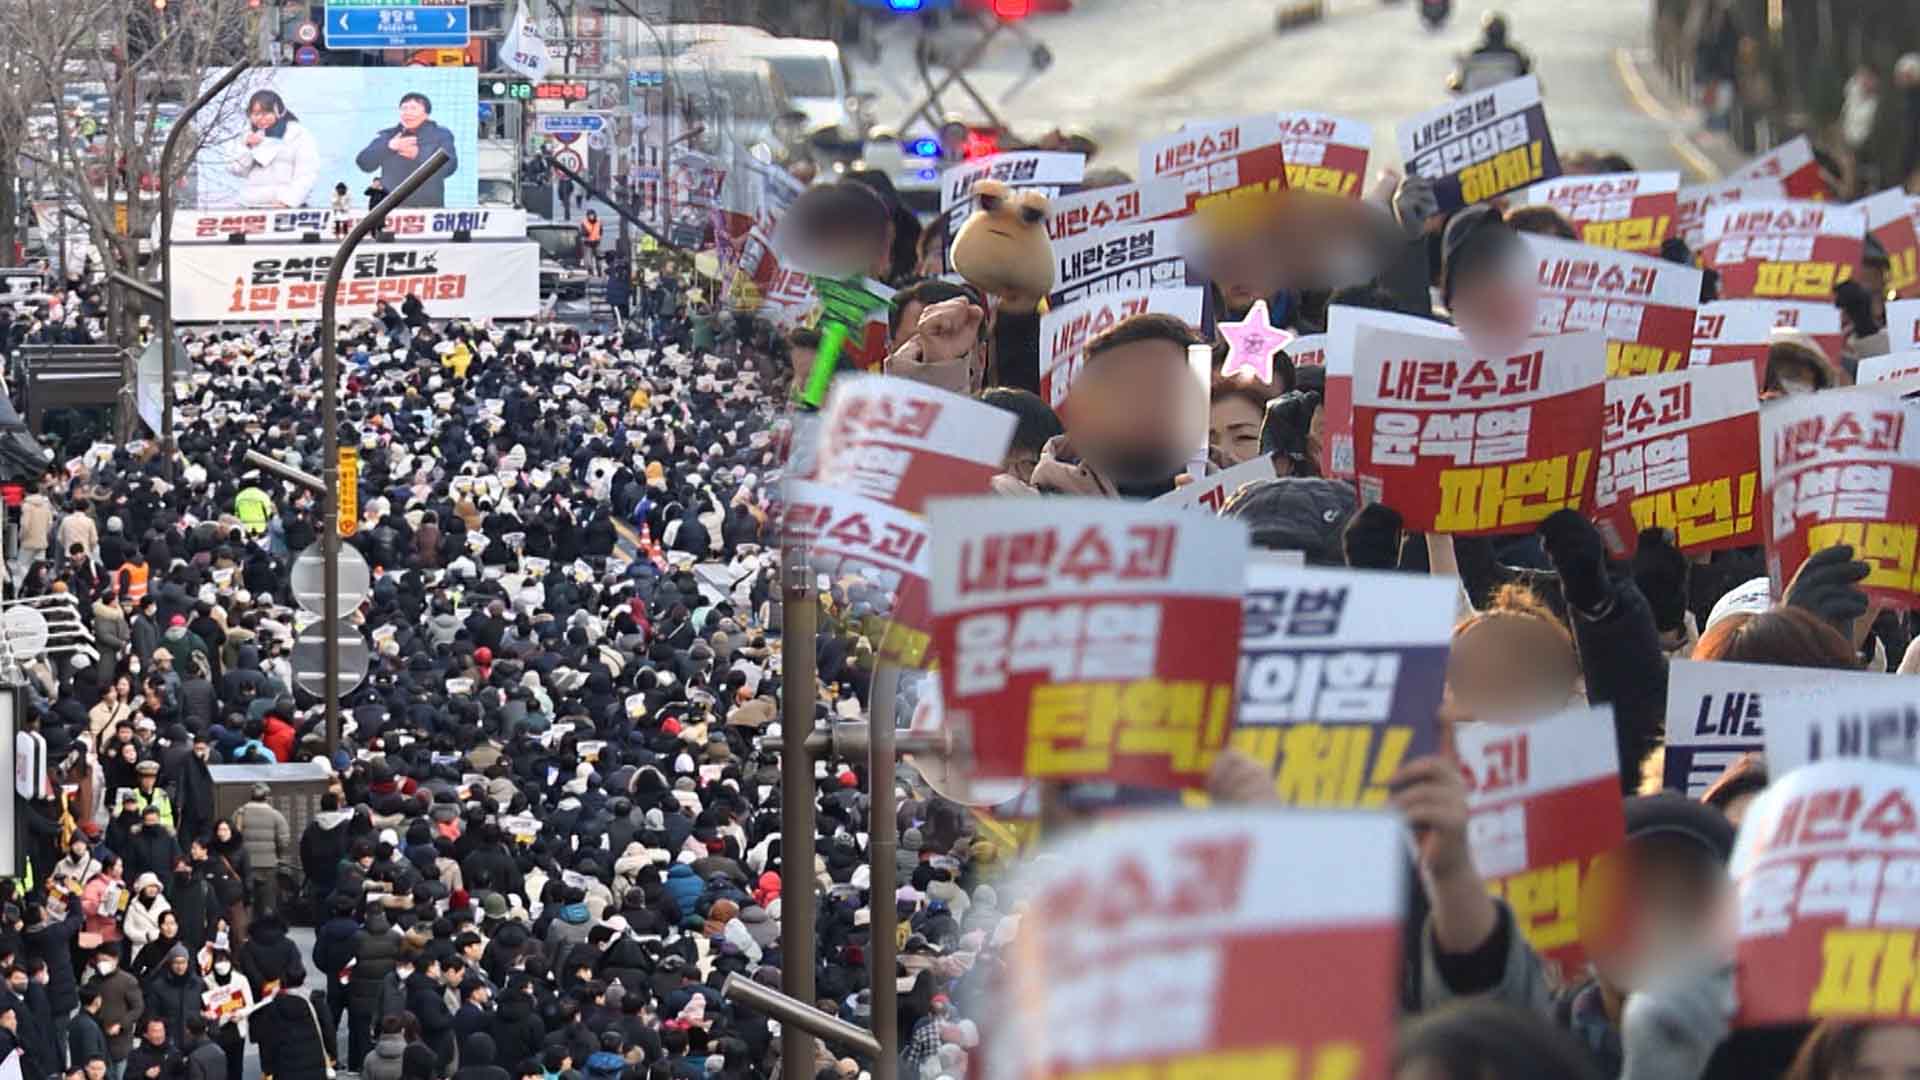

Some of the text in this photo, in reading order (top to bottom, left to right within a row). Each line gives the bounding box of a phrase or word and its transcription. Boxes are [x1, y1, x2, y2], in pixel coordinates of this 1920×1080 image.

[1155, 125, 1239, 176] 내란수괴
[1459, 139, 1544, 205] 해체!
[196, 215, 267, 236] 윤석열
[273, 211, 330, 232] 탄핵!
[432, 211, 488, 231] 해체!
[1046, 190, 1140, 241] 내란수괴
[354, 250, 438, 279] 퇴진
[1060, 230, 1155, 285] 내란공범
[1537, 258, 1658, 296] 내란수괴
[1378, 351, 1544, 402] 내란수괴
[1370, 405, 1534, 467] 윤석열
[1775, 411, 1905, 468] 내란수괴
[1434, 448, 1593, 533] 파면!
[1630, 471, 1757, 548] 파면!
[958, 525, 1177, 596] 내란수괴
[1808, 521, 1920, 594] 파면
[953, 601, 1163, 697] 윤석열
[1023, 678, 1232, 777] 탄핵!
[1808, 928, 1920, 1015] 파
